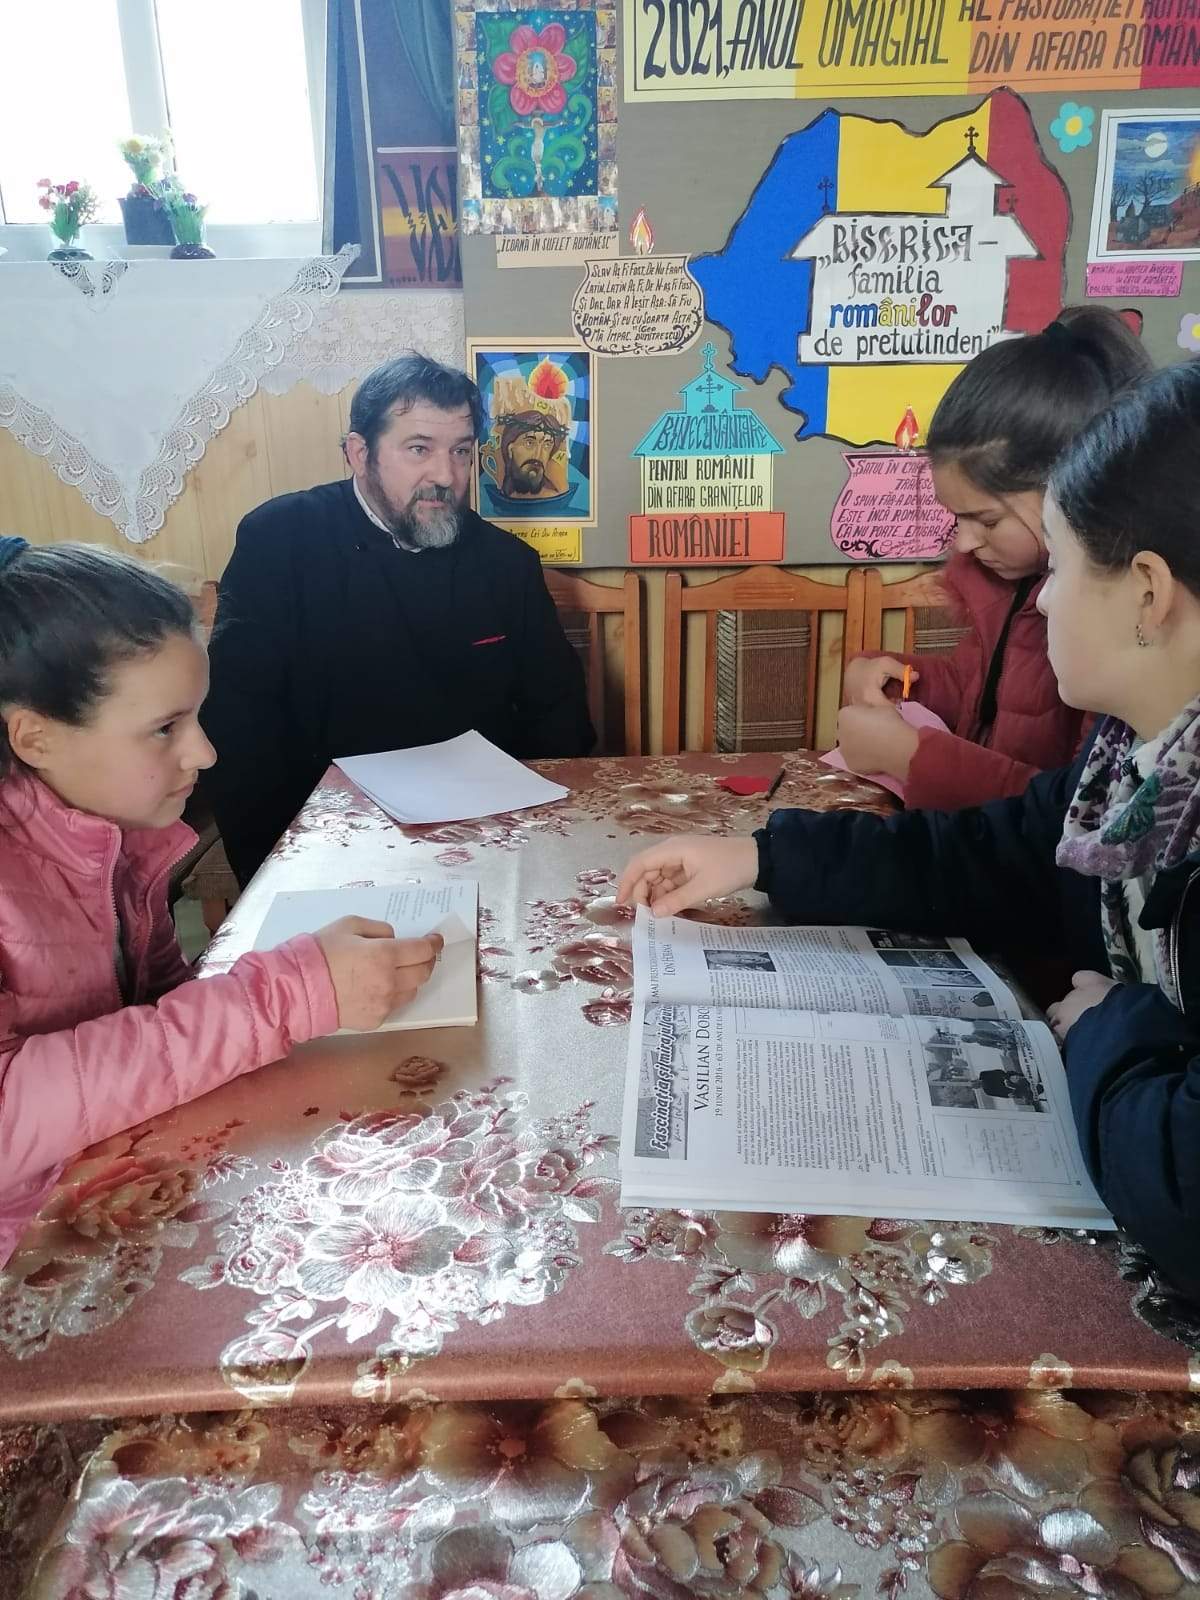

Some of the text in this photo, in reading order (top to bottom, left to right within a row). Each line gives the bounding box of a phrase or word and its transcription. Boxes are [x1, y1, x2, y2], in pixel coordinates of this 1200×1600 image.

[643, 0, 949, 80] 2021, ANUL OMAGIAL
[968, 26, 1020, 74] DIN
[1026, 30, 1107, 72] AFARA
[541, 236, 571, 251] SUFLET
[848, 262, 943, 299] familia
[829, 293, 958, 328] românilor
[814, 329, 842, 357] de
[648, 454, 754, 481] PENTRU ROMÂNII
[648, 483, 663, 508] DIN
[666, 486, 696, 508] AFARA
[647, 512, 750, 558] ROMÂNIEI
[694, 1045, 710, 1111] VASILIAN
